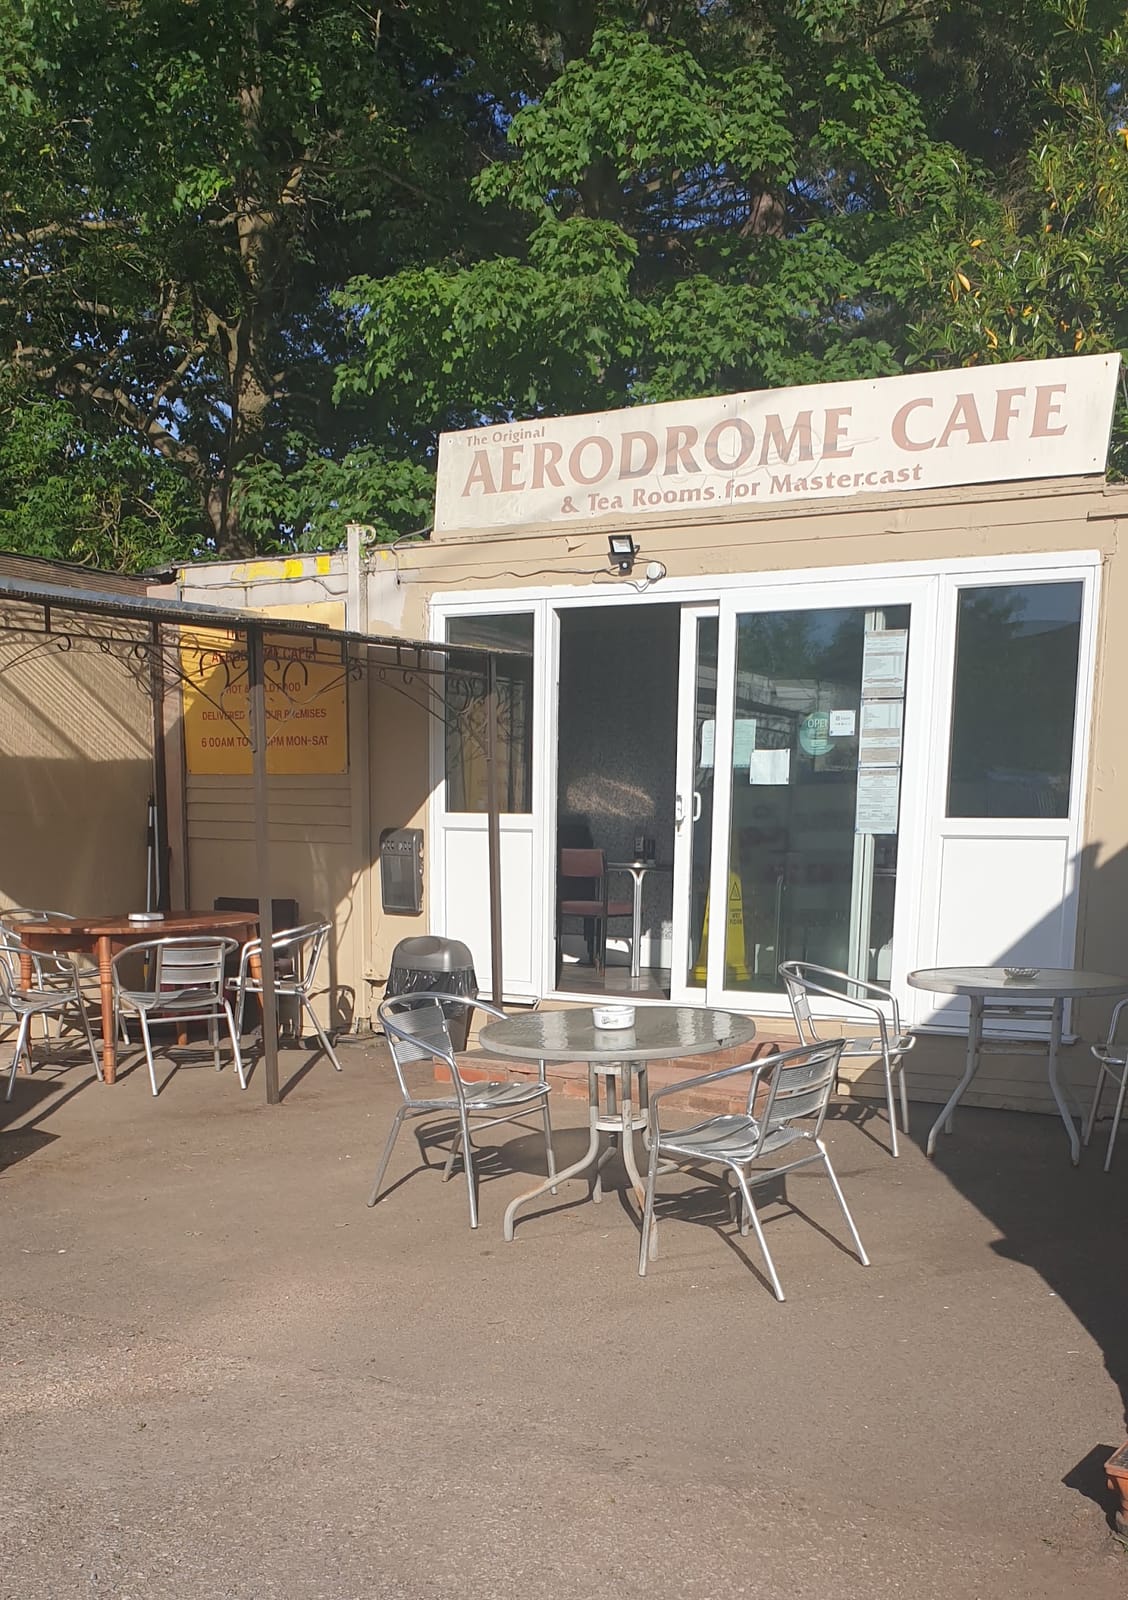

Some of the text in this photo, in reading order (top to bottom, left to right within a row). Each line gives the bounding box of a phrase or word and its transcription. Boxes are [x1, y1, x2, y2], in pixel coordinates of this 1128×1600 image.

[461, 384, 1068, 497] AERODROME CAFE
[466, 426, 545, 447] The Original
[560, 463, 923, 514] & Tea Rooms for Mastercast
[202, 710, 245, 721] DELIVERED
[807, 718, 827, 728] OPE
[236, 736, 249, 747] TO
[286, 735, 329, 746] MON-SAT
